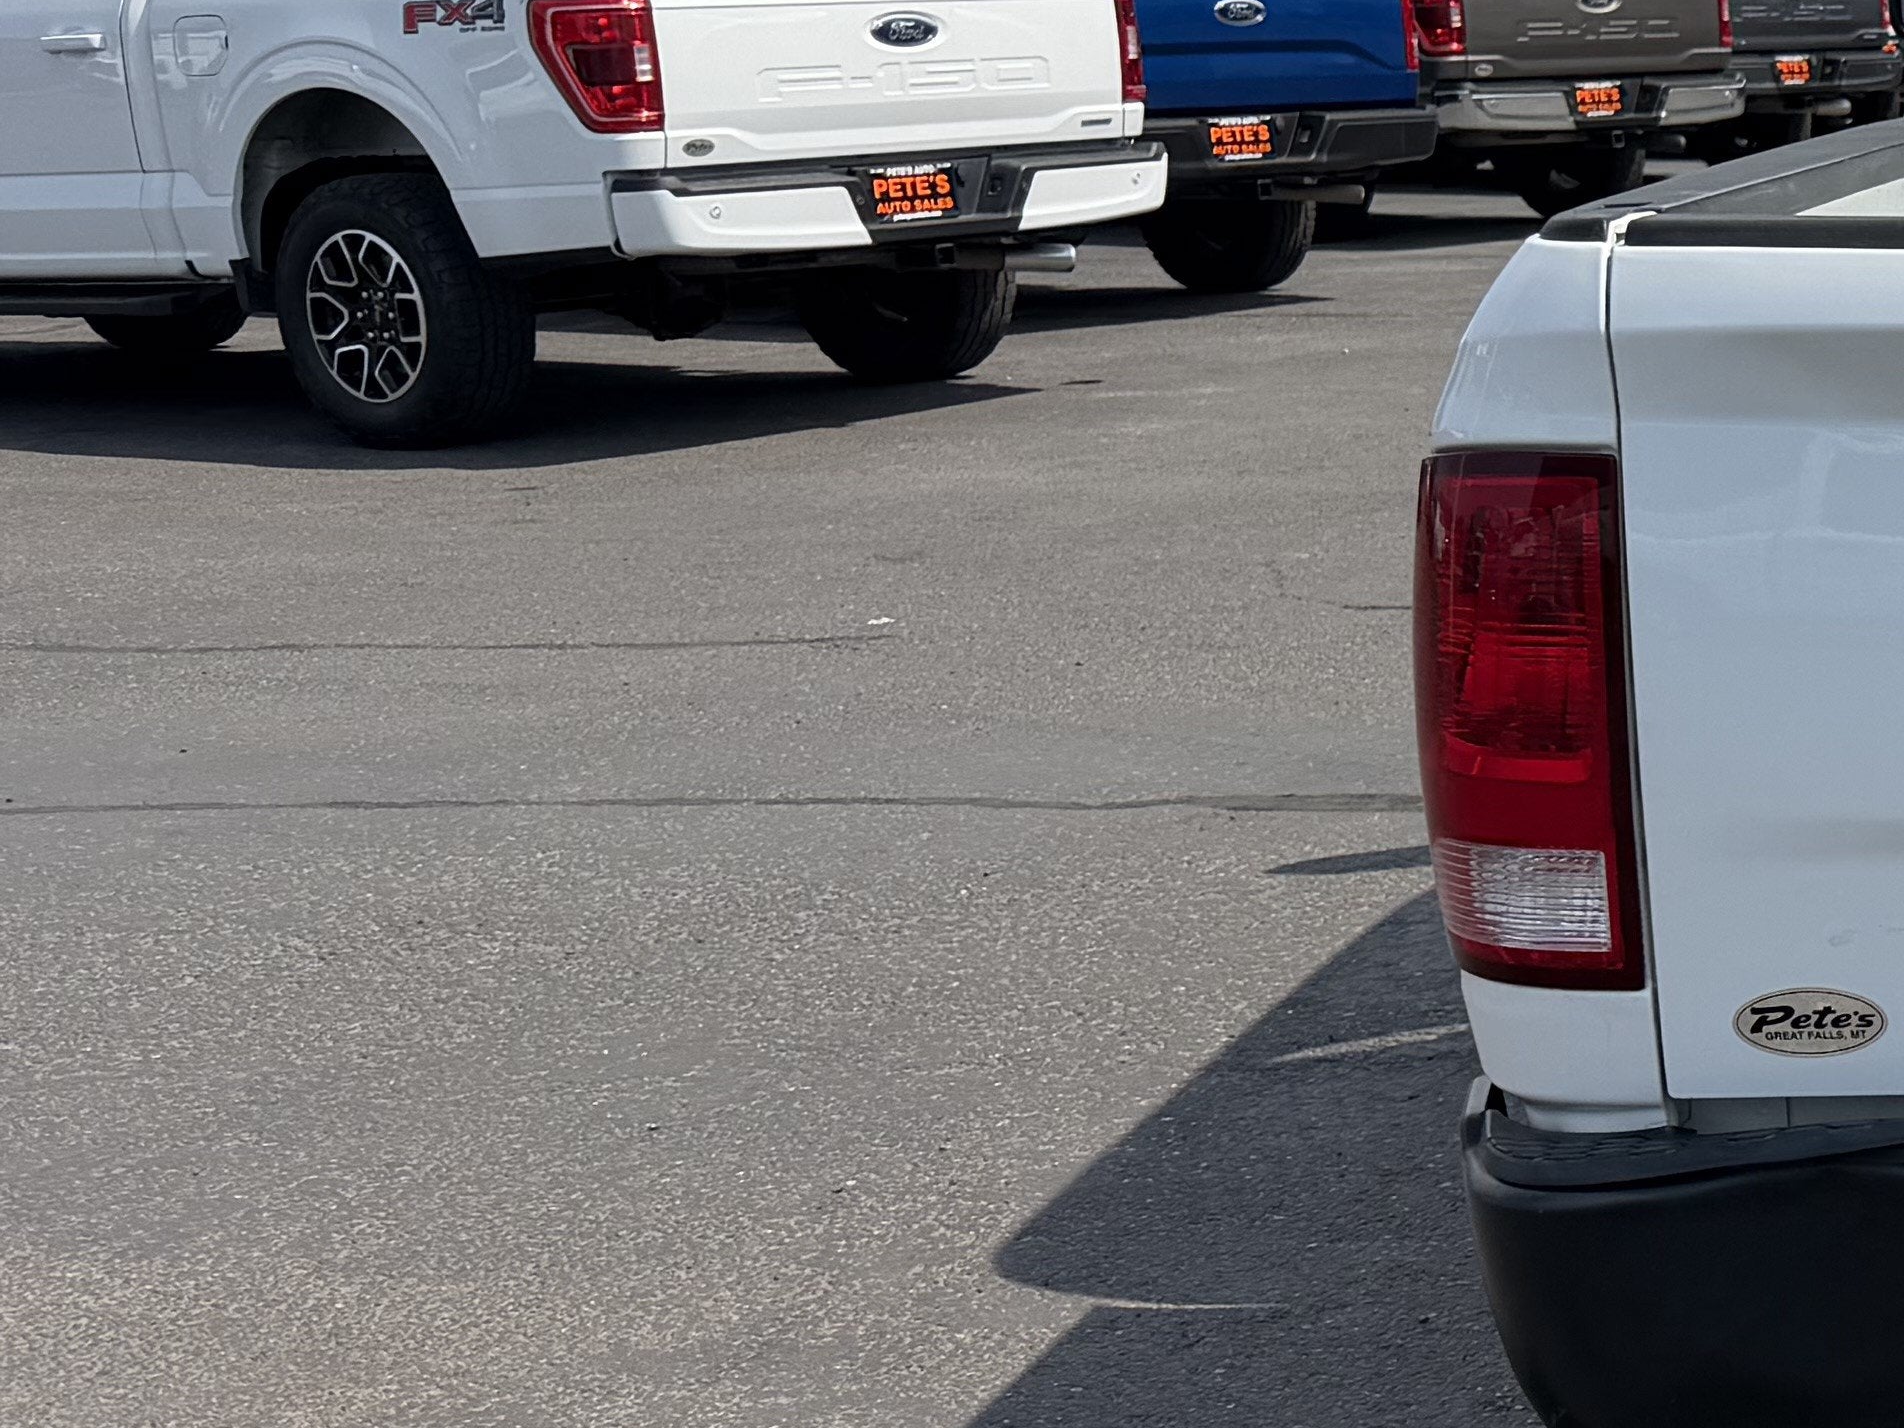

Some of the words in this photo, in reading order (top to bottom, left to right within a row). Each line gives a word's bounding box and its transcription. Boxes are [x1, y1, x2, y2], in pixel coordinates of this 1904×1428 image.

[756, 55, 1051, 103] F-150
[1210, 124, 1270, 143] PETE'S
[873, 174, 950, 199] PETE'S
[877, 201, 911, 214] AUTO
[914, 196, 954, 211] SALES
[1750, 1005, 1876, 1034] Pete's
[1765, 1030, 1801, 1041] GREAT
[1808, 1030, 1848, 1041] FALLS,
[1851, 1029, 1866, 1039] MT
